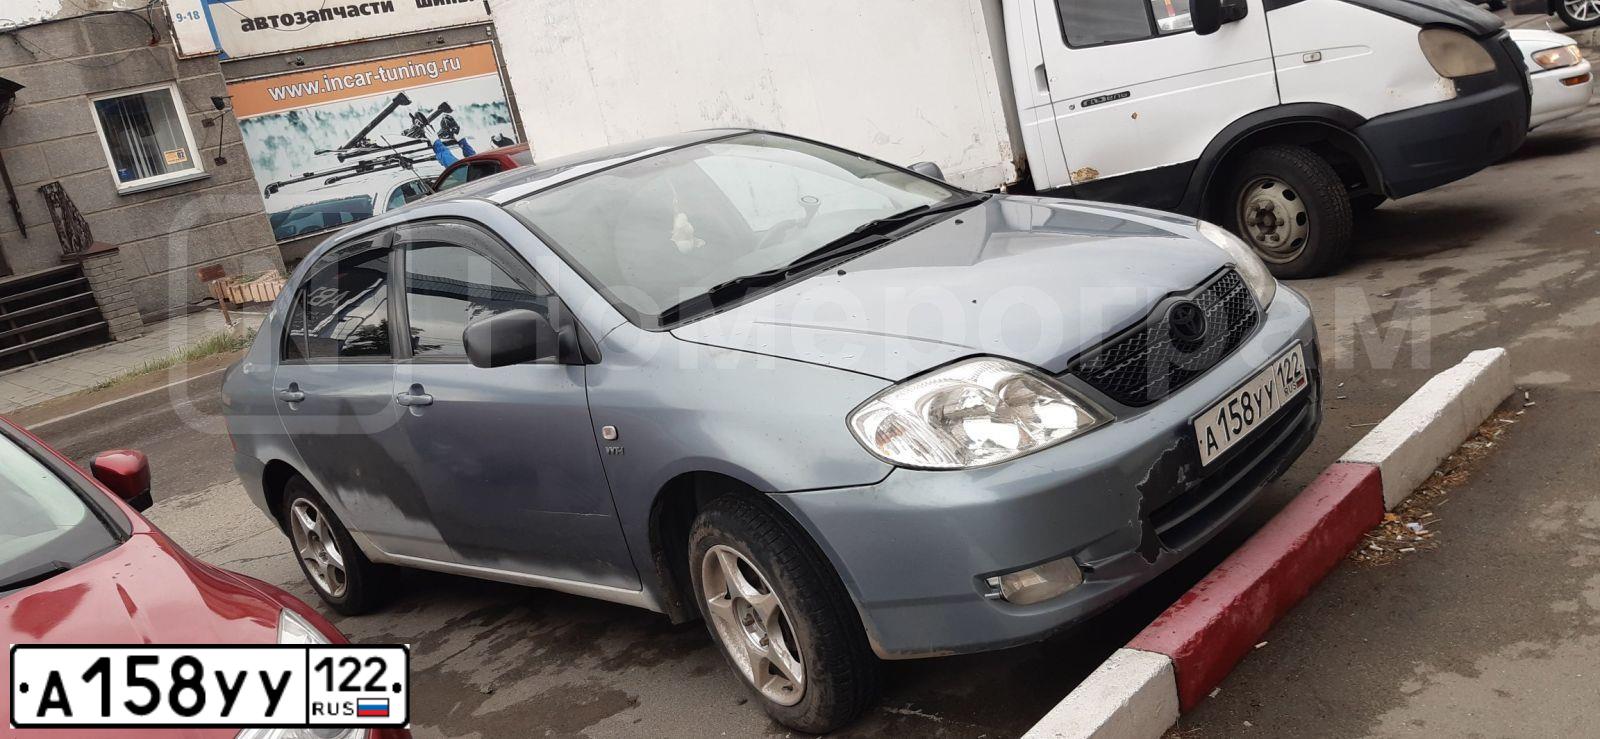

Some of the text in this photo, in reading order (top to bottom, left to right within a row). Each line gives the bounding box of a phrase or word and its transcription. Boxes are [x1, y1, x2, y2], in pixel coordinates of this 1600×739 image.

[240, 0, 395, 33] автозапчасти
[268, 57, 462, 101] www.incar-tuning.ru
[1277, 352, 1301, 388] 122
[1284, 382, 1298, 395] RUS
